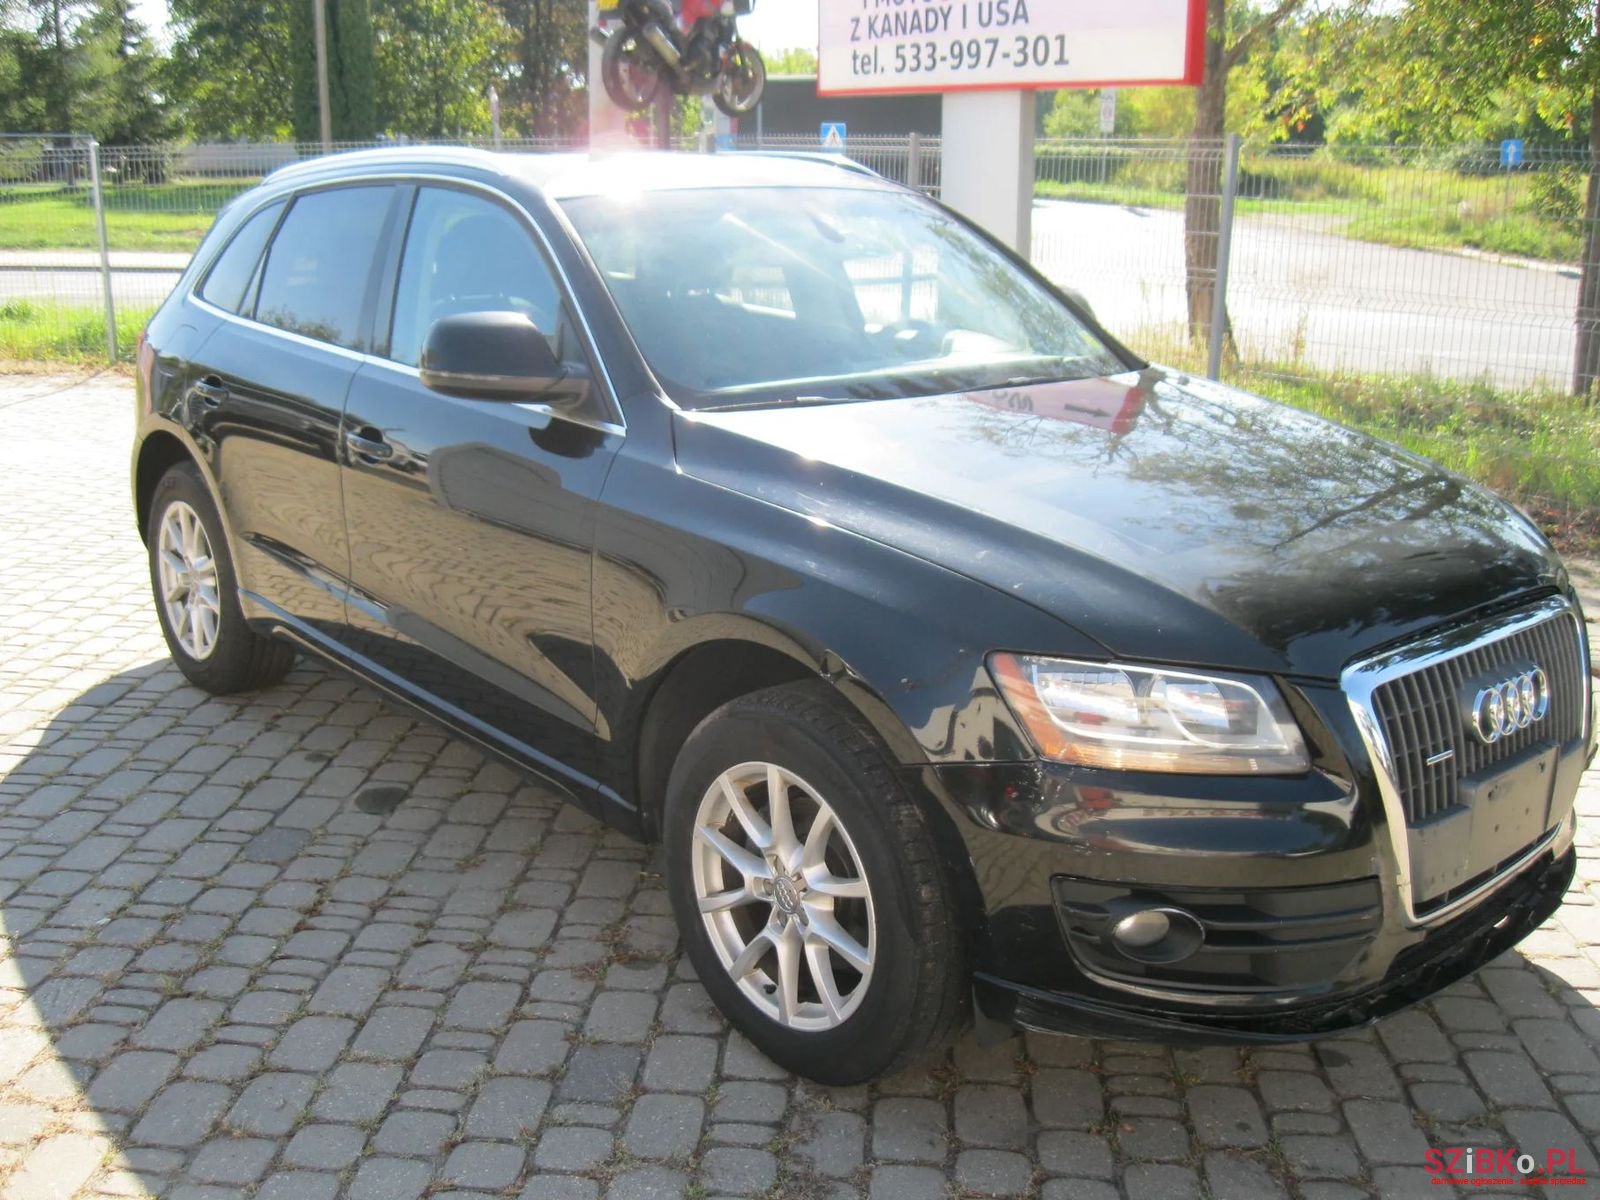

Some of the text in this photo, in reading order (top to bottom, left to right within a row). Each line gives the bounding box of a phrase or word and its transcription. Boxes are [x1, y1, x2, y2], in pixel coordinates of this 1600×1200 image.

[850, 0, 1030, 41] Z KANADY I USA
[851, 34, 1070, 75] tel. 533-997-301
